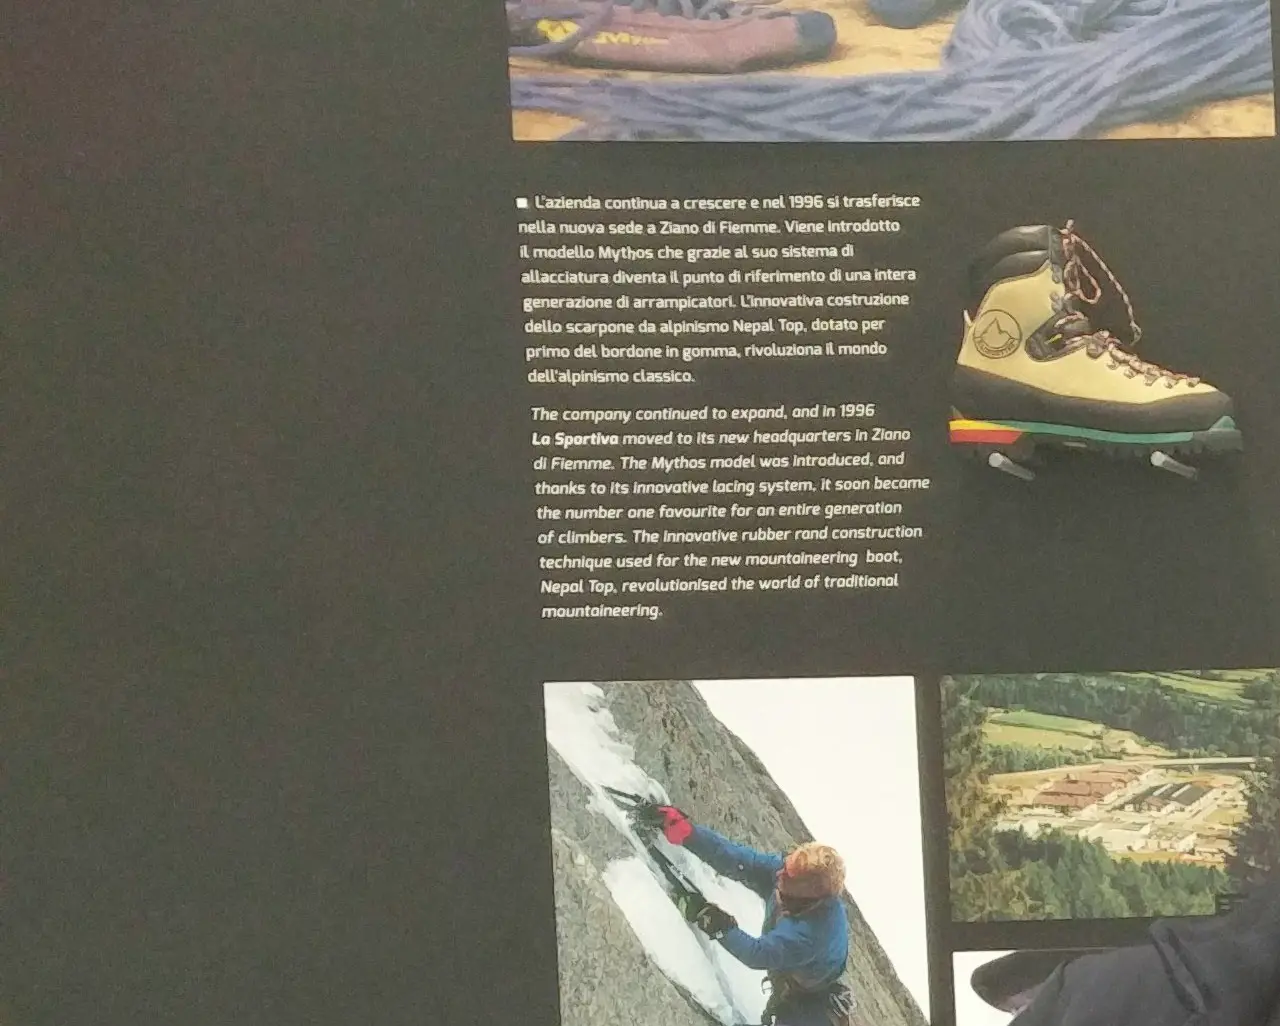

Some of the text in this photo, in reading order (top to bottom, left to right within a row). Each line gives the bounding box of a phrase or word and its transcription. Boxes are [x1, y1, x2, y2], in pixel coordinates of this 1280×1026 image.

[534, 193, 921, 210] L'azienda continua a crescere e nel 1996 si trasferisce
[518, 219, 556, 234] nella
[559, 223, 605, 234] nuova
[608, 220, 644, 235] sede
[646, 223, 657, 235] a
[659, 220, 700, 235] Ziano
[702, 220, 716, 234] di
[784, 220, 825, 233] Viene
[827, 218, 900, 233] introdotto
[519, 243, 855, 263] il modello Mythos che grazie al suo sistema di
[523, 295, 613, 313] generazione
[616, 294, 630, 309] di
[740, 294, 824, 308] L'innovativa
[826, 293, 910, 307] costruzione
[524, 319, 563, 333] dello
[565, 322, 635, 337] scarpone
[638, 319, 657, 333] da
[659, 319, 730, 337] alpinismo
[732, 318, 775, 336] Nepal
[811, 317, 859, 331] dotato
[861, 319, 886, 334] per
[527, 368, 630, 387] dell'alpinismo
[531, 406, 559, 421] The
[562, 410, 632, 424] company
[635, 406, 709, 421] continued
[711, 407, 728, 420] to
[791, 404, 820, 418] and
[822, 404, 836, 418] in
[839, 403, 876, 417] 1996
[531, 427, 911, 450] La Sportiva moved to its new headquarters in Ziano
[533, 456, 548, 470] di
[620, 455, 648, 470] The
[650, 455, 707, 473] Mythos
[709, 454, 756, 469] model
[759, 456, 790, 468] was
[877, 451, 905, 465] and
[539, 554, 613, 572] technique
[616, 553, 653, 568] used
[656, 553, 681, 567] for
[683, 552, 708, 567] the
[711, 555, 742, 567] new
[744, 550, 858, 568] mountaineering
[540, 578, 584, 597] Nepal
[621, 576, 728, 593] revolutionised
[730, 576, 755, 591] the
[758, 574, 802, 590] world
[804, 574, 821, 589] of
[823, 572, 899, 589] traditional
